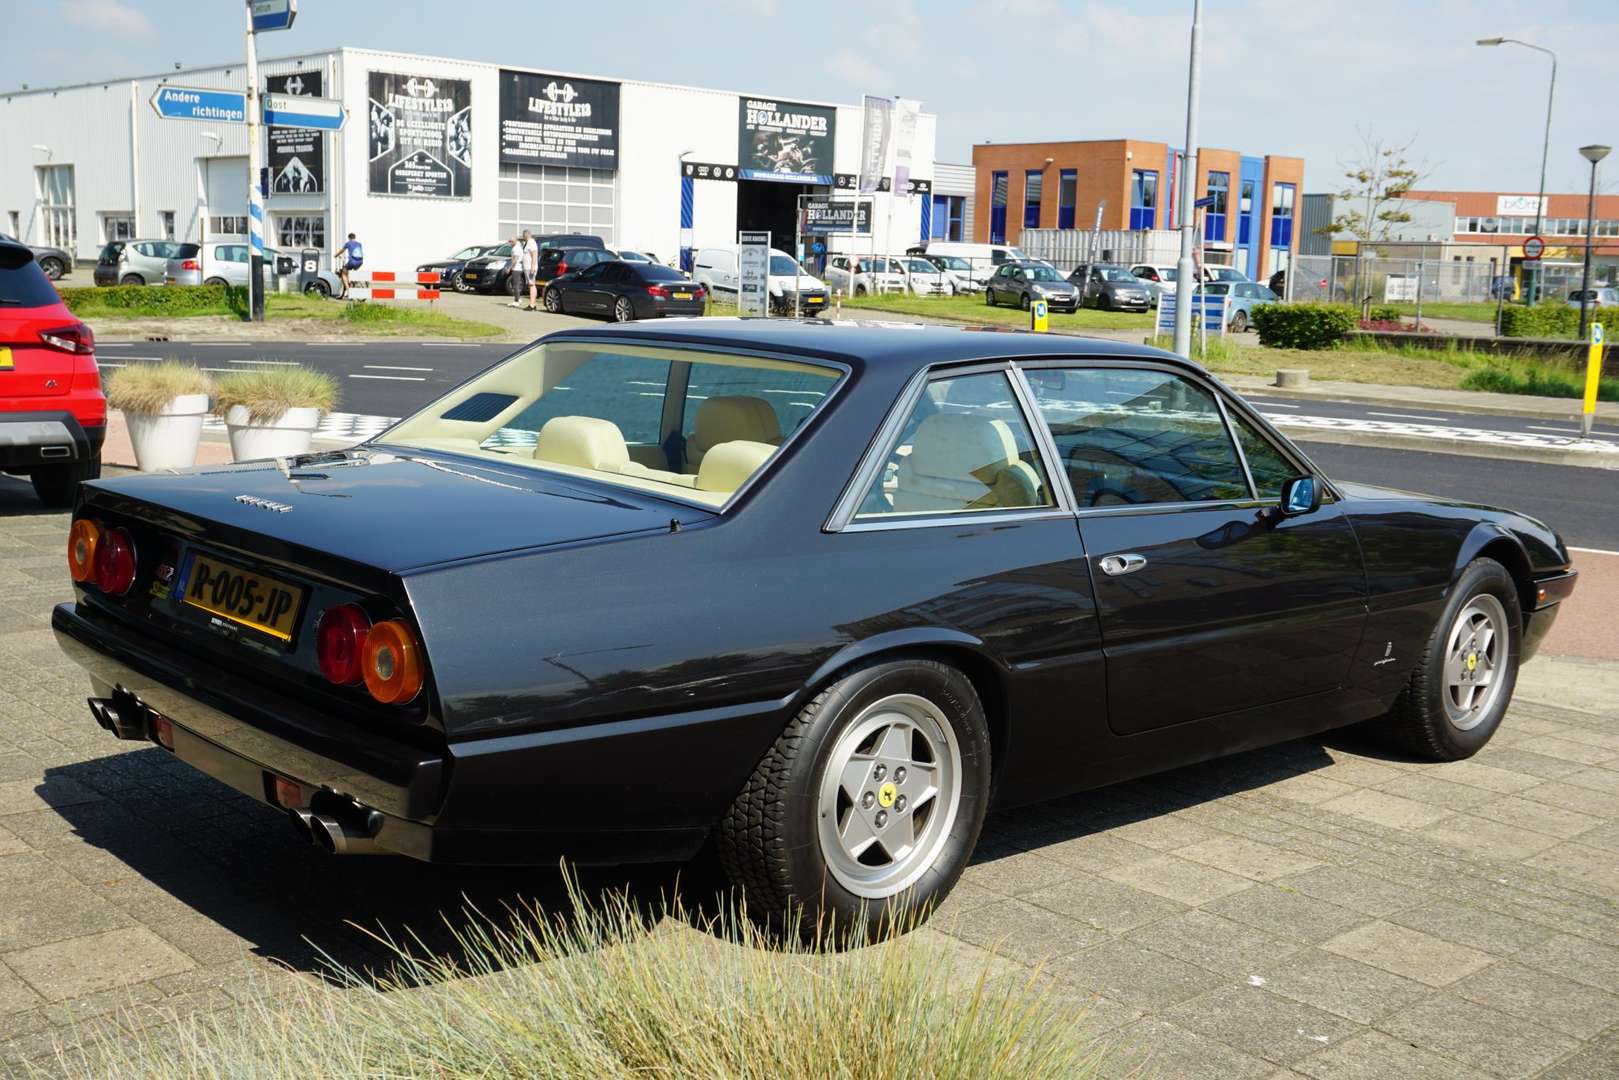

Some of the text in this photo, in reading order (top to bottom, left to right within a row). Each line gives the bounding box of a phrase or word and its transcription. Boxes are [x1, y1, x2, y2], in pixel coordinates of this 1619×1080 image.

[164, 90, 200, 104] Andere
[267, 98, 287, 110] Oost
[746, 99, 777, 112] GARAGE
[192, 105, 243, 121] richtingen
[746, 109, 828, 131] HOLLANDER
[304, 260, 317, 273] 8
[190, 562, 293, 627] R-005-JP
